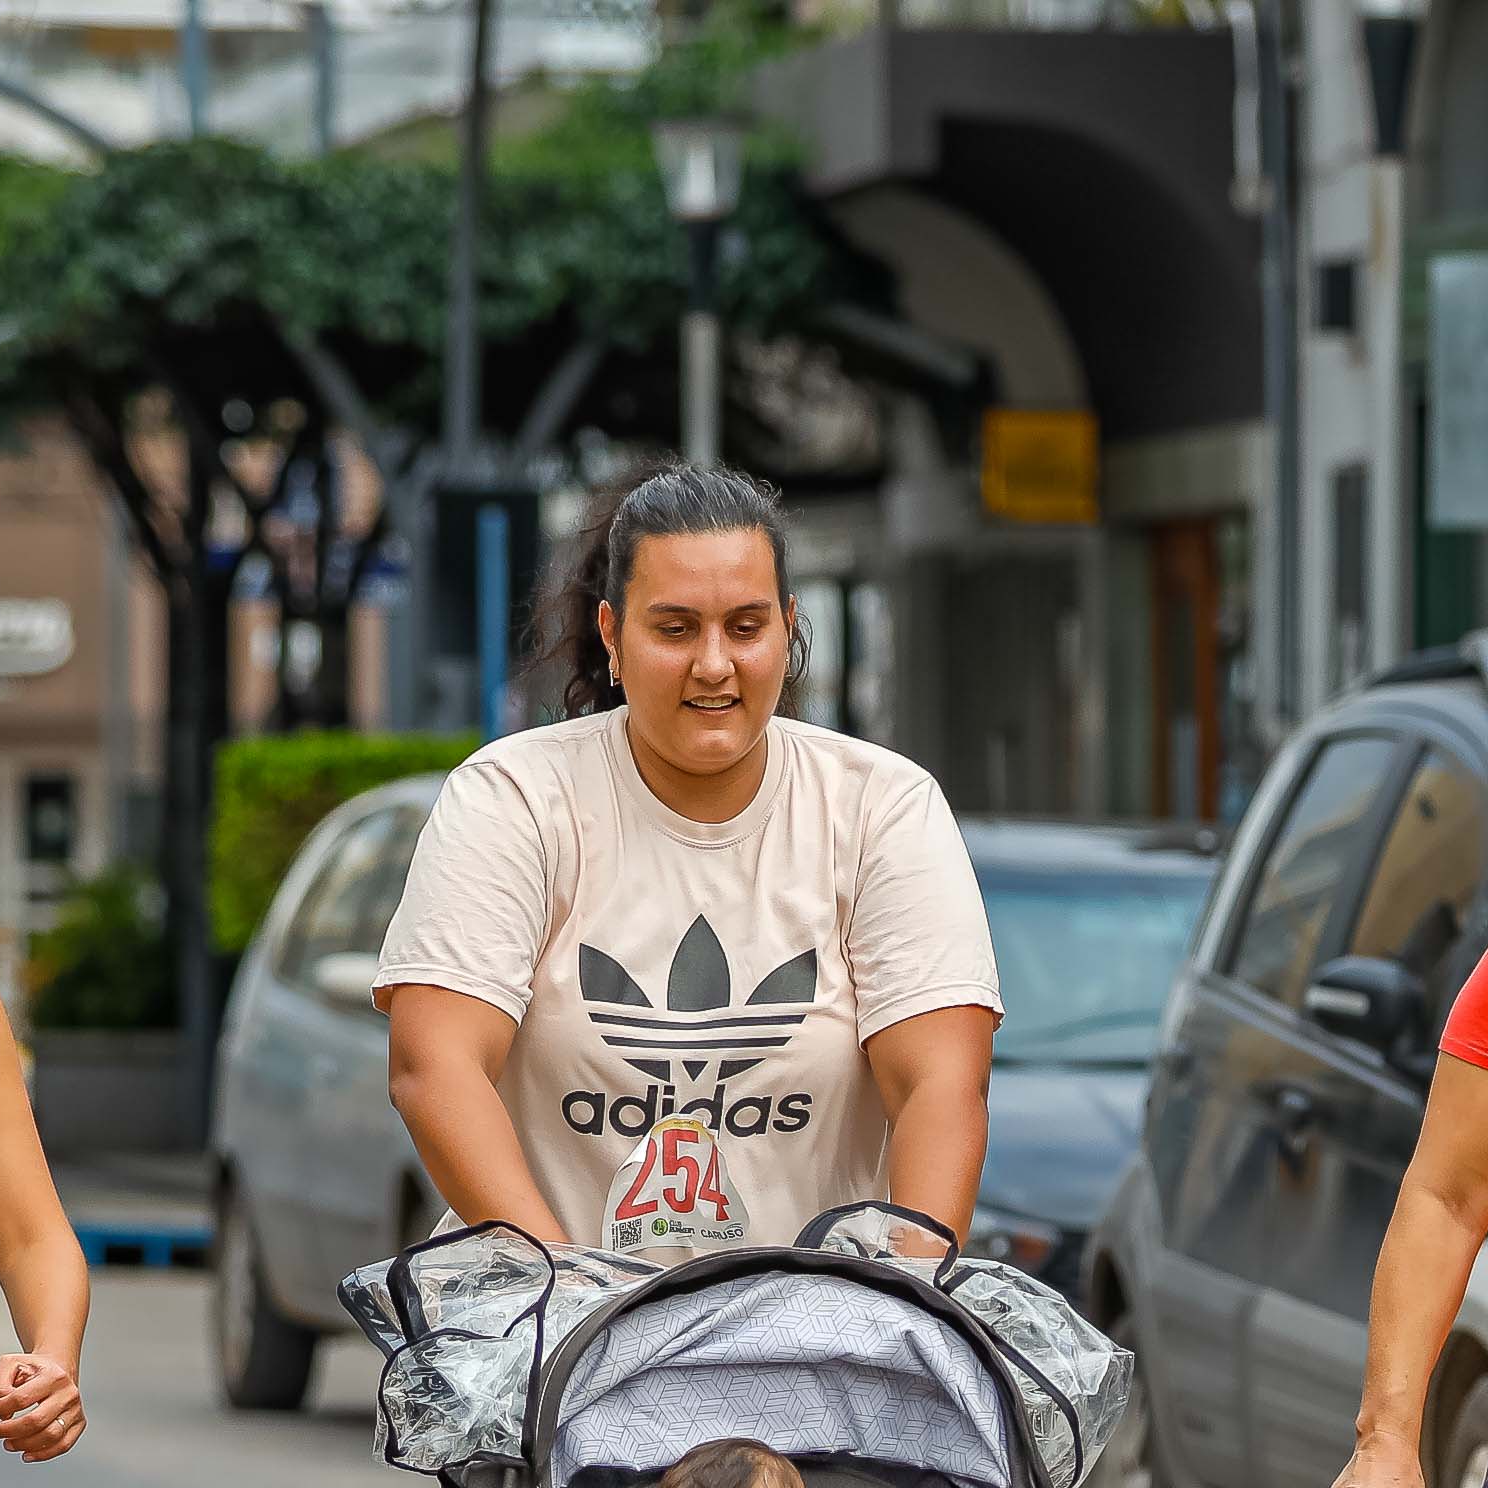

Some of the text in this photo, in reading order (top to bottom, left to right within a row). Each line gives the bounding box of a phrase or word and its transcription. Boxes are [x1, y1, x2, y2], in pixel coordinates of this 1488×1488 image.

[561, 1083, 812, 1138] adidas
[614, 1128, 730, 1222] 254
[700, 1228, 744, 1240] CARUSO
